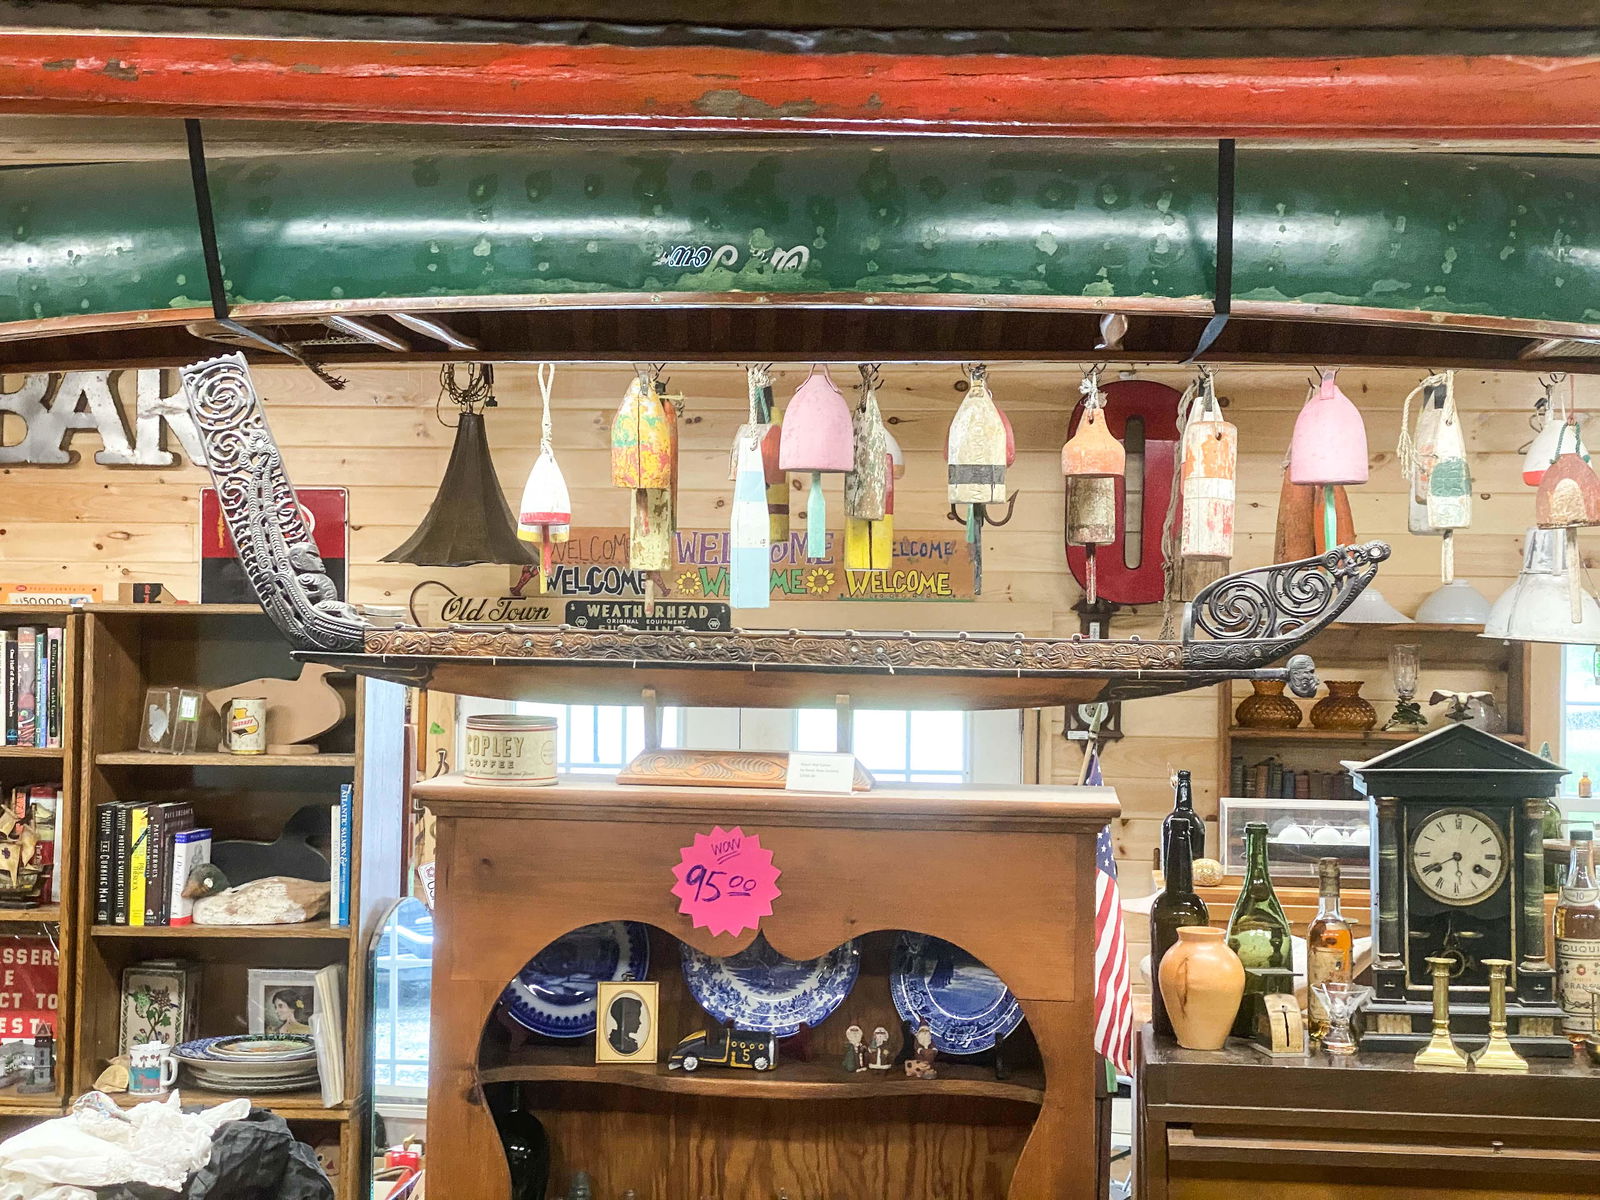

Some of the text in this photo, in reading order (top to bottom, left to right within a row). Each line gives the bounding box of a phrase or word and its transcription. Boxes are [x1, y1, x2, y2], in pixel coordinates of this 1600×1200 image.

[892, 540, 954, 560] ELCOME
[547, 566, 647, 597] WELCOME
[845, 569, 953, 597] WELCOME
[441, 594, 551, 622] Old Town
[586, 603, 709, 619] WEATHRHEAD
[466, 734, 525, 758] COPLEY
[469, 758, 515, 769] COFFEE
[711, 837, 741, 855] WOW
[36, 993, 58, 1010] TO
[742, 1048, 750, 1062] 5
